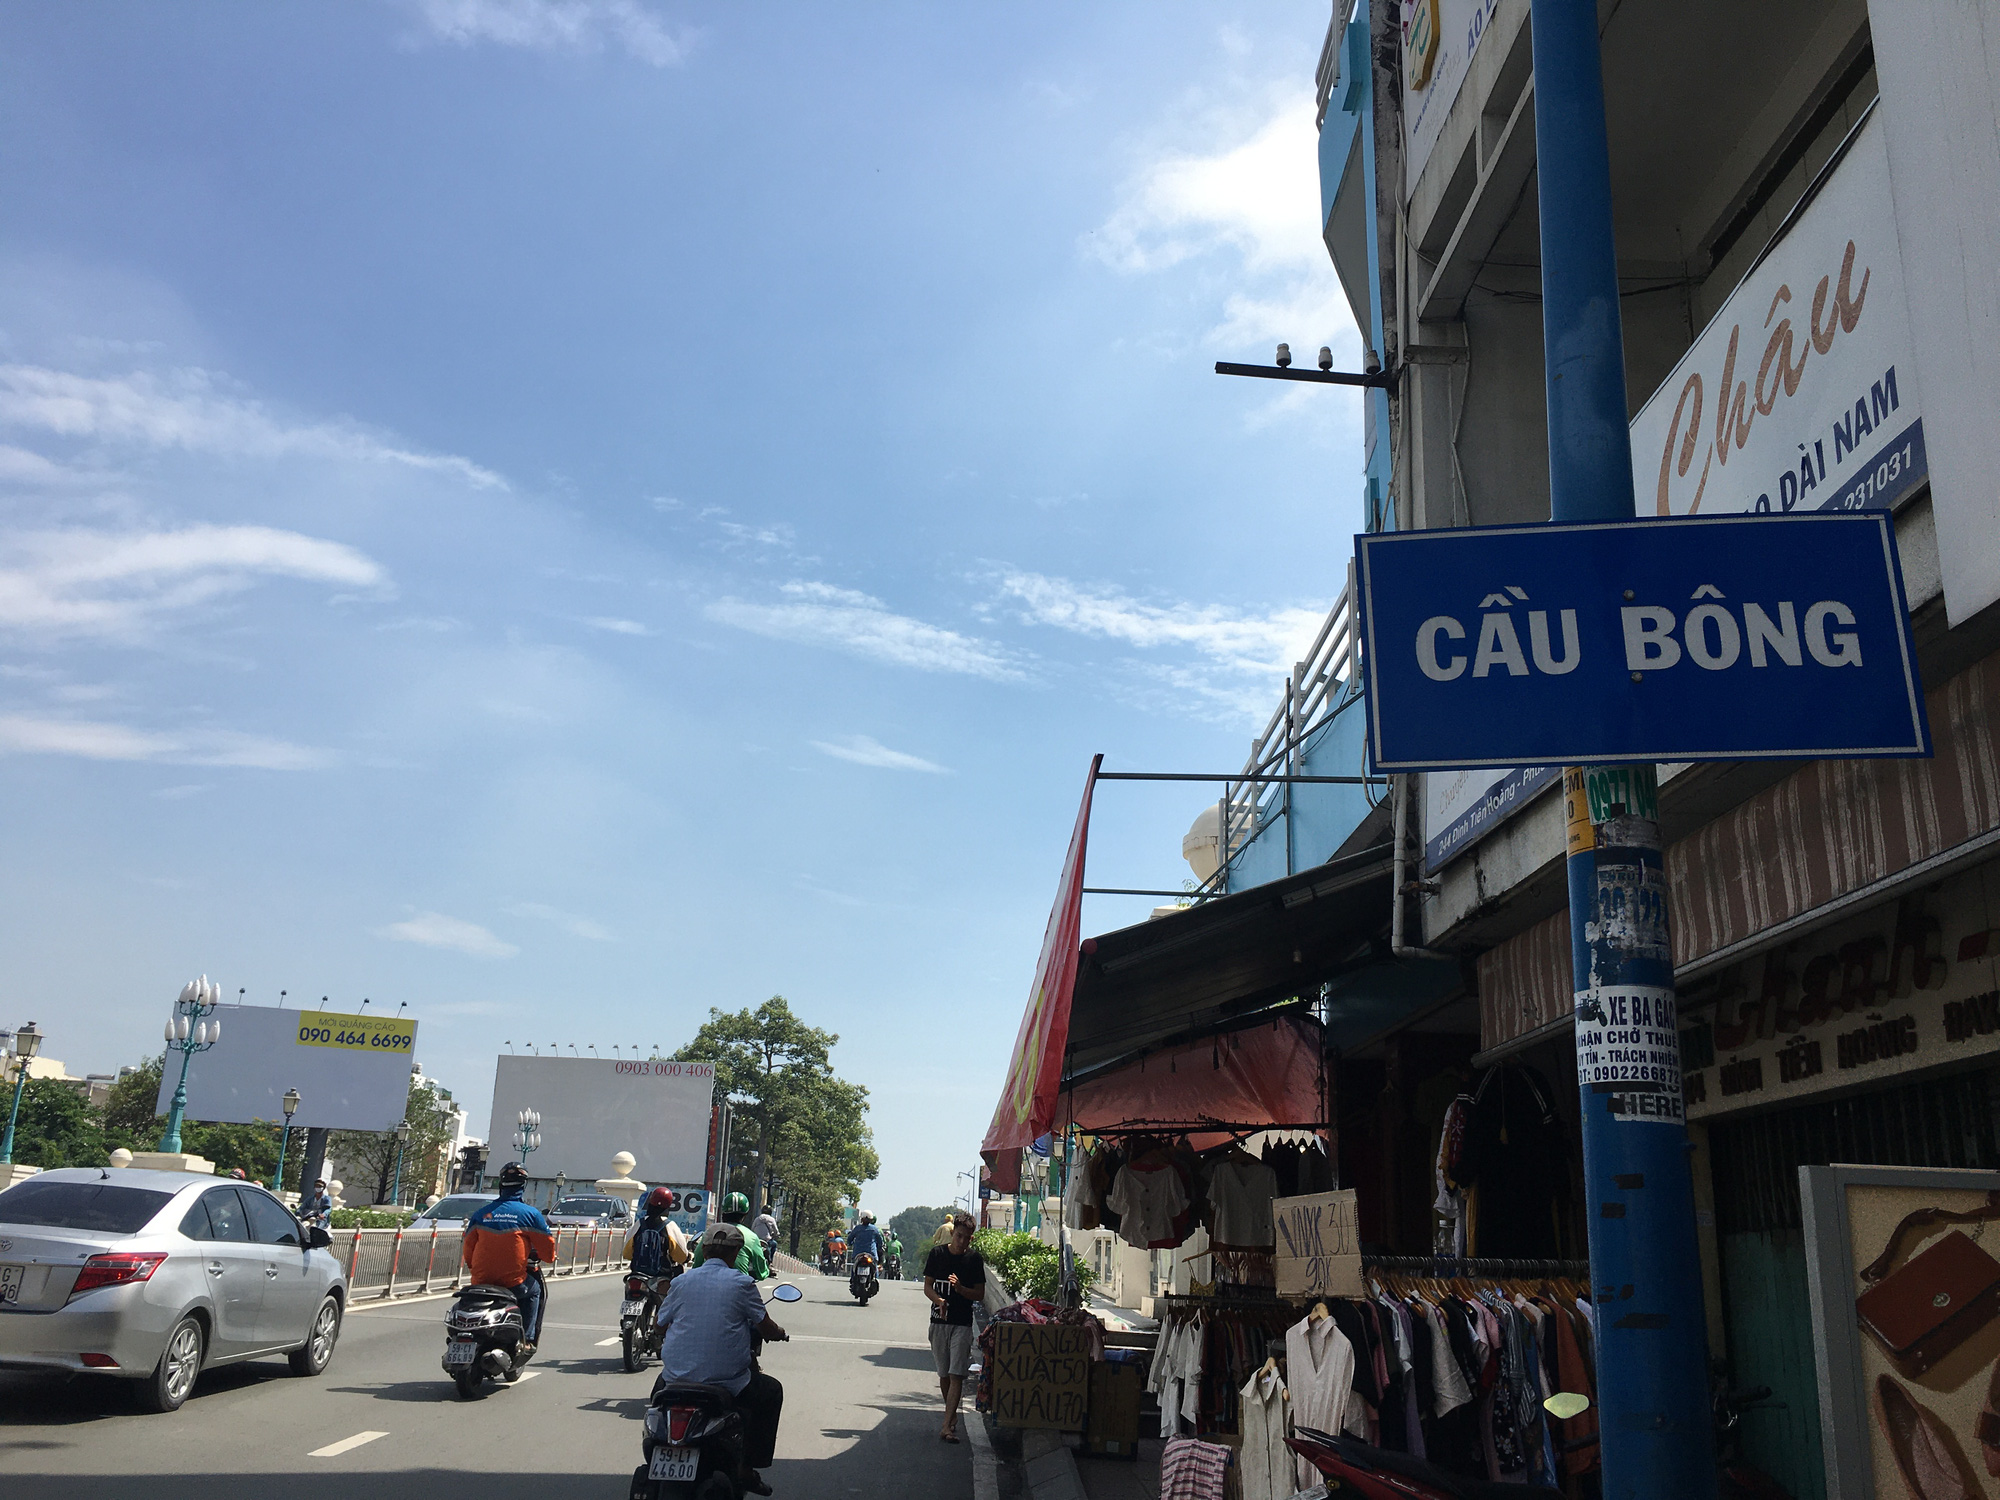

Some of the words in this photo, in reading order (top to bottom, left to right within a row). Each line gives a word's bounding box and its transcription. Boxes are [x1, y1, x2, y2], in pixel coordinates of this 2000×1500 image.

[1833, 364, 1899, 464] NAM
[1415, 585, 1581, 681] CẦU
[1620, 584, 1863, 671] BÔNG
[1609, 996, 1627, 1026] XE
[1632, 996, 1652, 1026] BA
[299, 1027, 331, 1043] 090
[335, 1030, 366, 1045] 464
[371, 1033, 411, 1048] 6699
[1608, 1047, 1646, 1062] TRÁCH
[615, 1061, 650, 1075] 0903
[655, 1063, 682, 1076] 000
[685, 1064, 712, 1078] 406
[1594, 1066, 1679, 1083] 0902266872
[659, 1449, 691, 1463] 59-L1
[652, 1463, 694, 1478] 446.00
